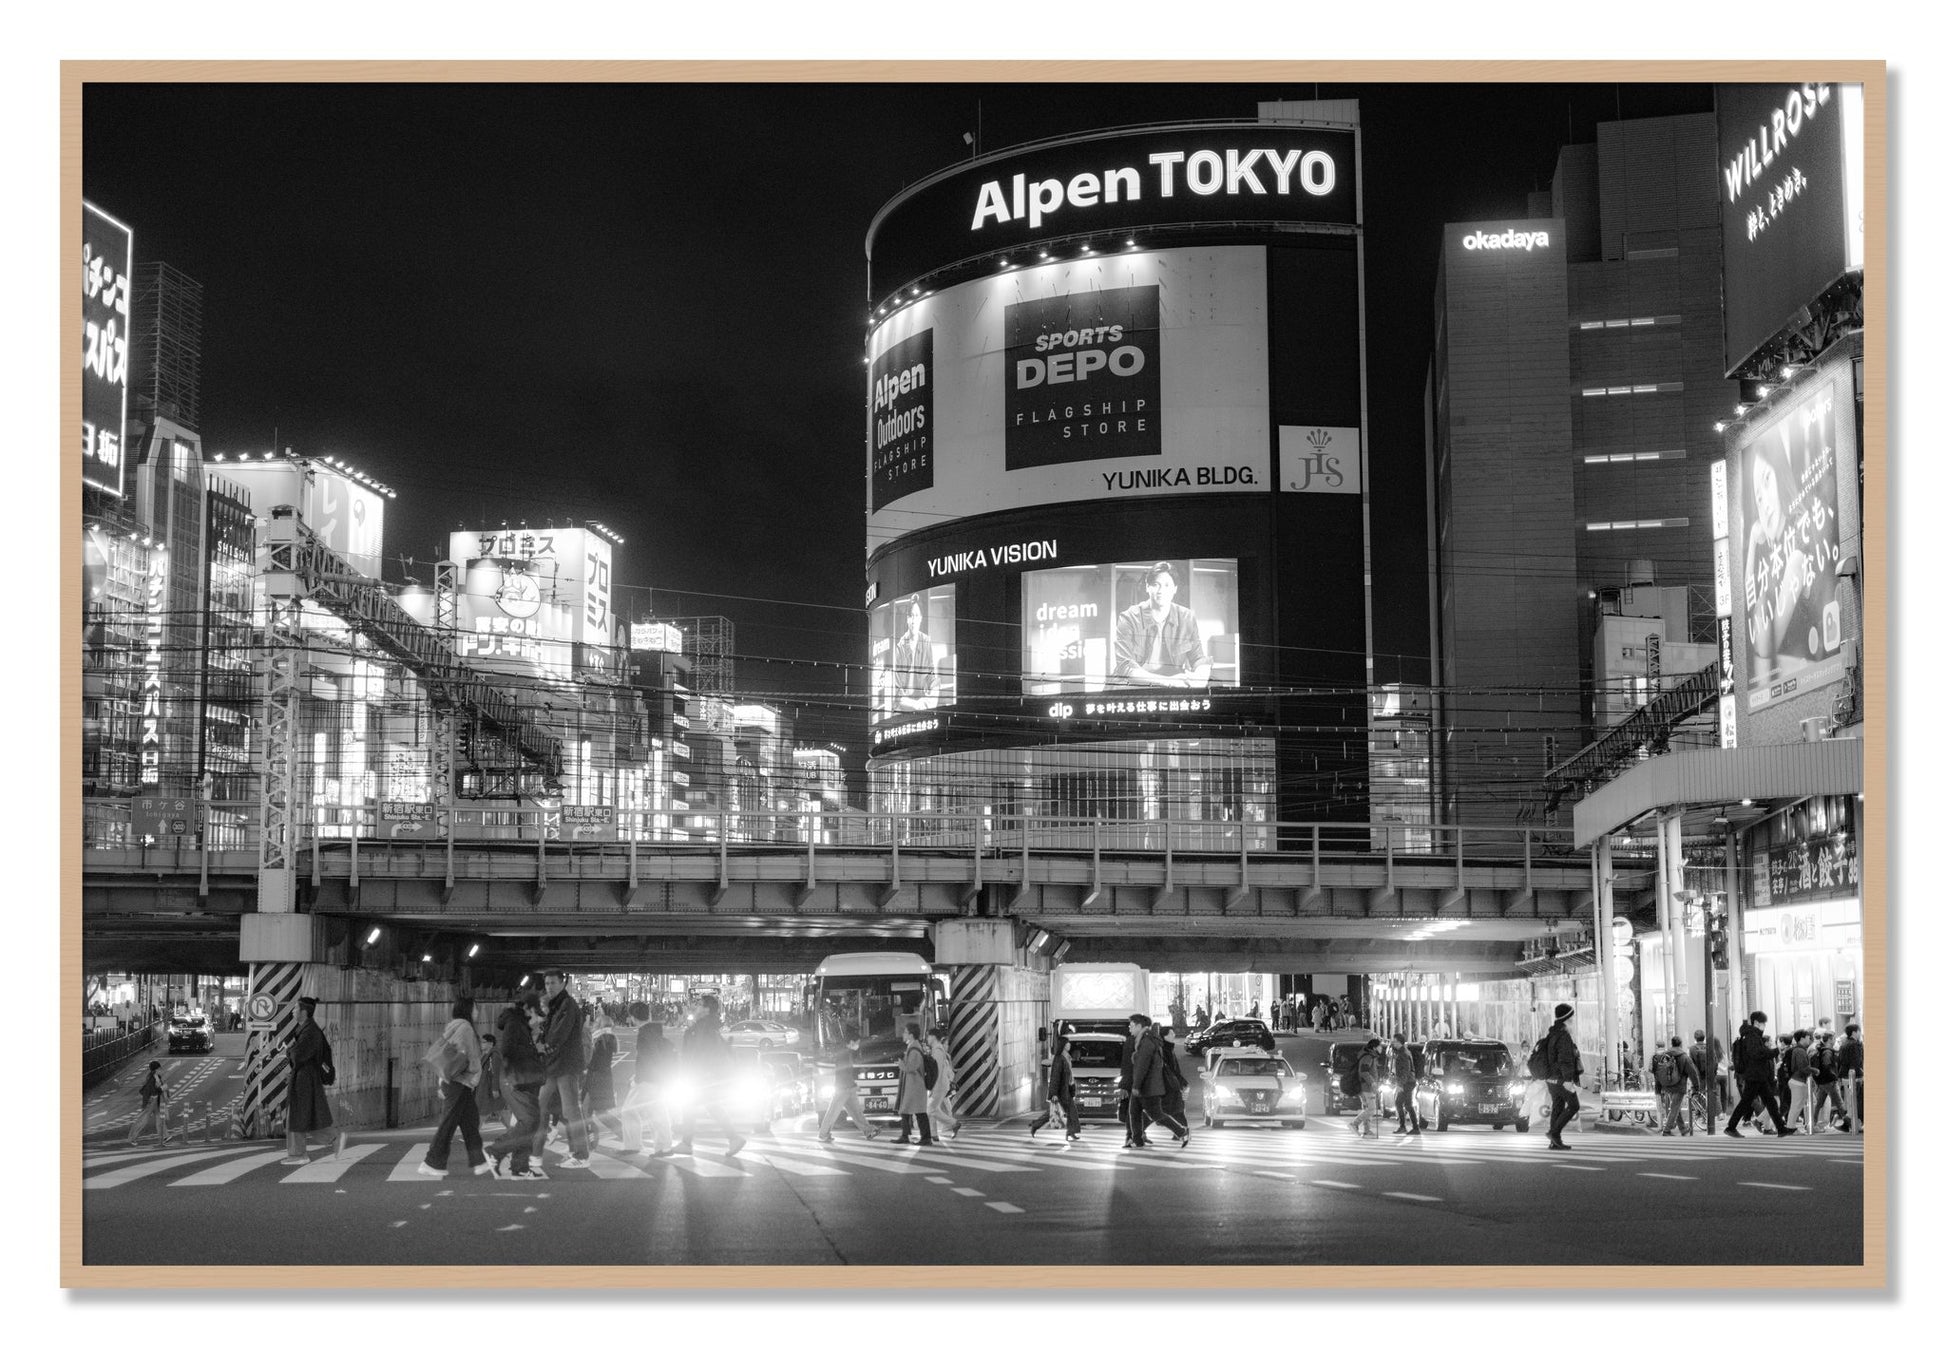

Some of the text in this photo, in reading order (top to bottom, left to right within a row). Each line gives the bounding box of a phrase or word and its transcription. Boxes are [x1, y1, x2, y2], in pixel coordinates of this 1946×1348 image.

[970, 149, 1336, 231] Alpen TOKYO
[1462, 228, 1550, 252] okadaya
[1035, 324, 1124, 352] SPORTS
[83, 319, 126, 388] スパス
[1016, 345, 1146, 390] DEPO
[874, 363, 926, 414] Alpen
[1016, 399, 1146, 426] FLAGSHIP
[877, 404, 925, 450] Outdoors
[1063, 418, 1146, 438] STORE
[874, 436, 927, 473] FLAGSHIP
[888, 454, 927, 481] STORE
[1102, 465, 1259, 491] YUNIKA BLDG.
[217, 540, 250, 563] SHISHA
[478, 534, 556, 557] プロミス
[927, 539, 1057, 578] YUNIKA VISION
[1036, 602, 1098, 621] dream
[1048, 702, 1074, 719] dip
[1085, 699, 1211, 715] 夢を叶える仕事に出会おう
[382, 803, 433, 814] 新宿駅東口
[563, 806, 611, 817] 新宿駅東口
